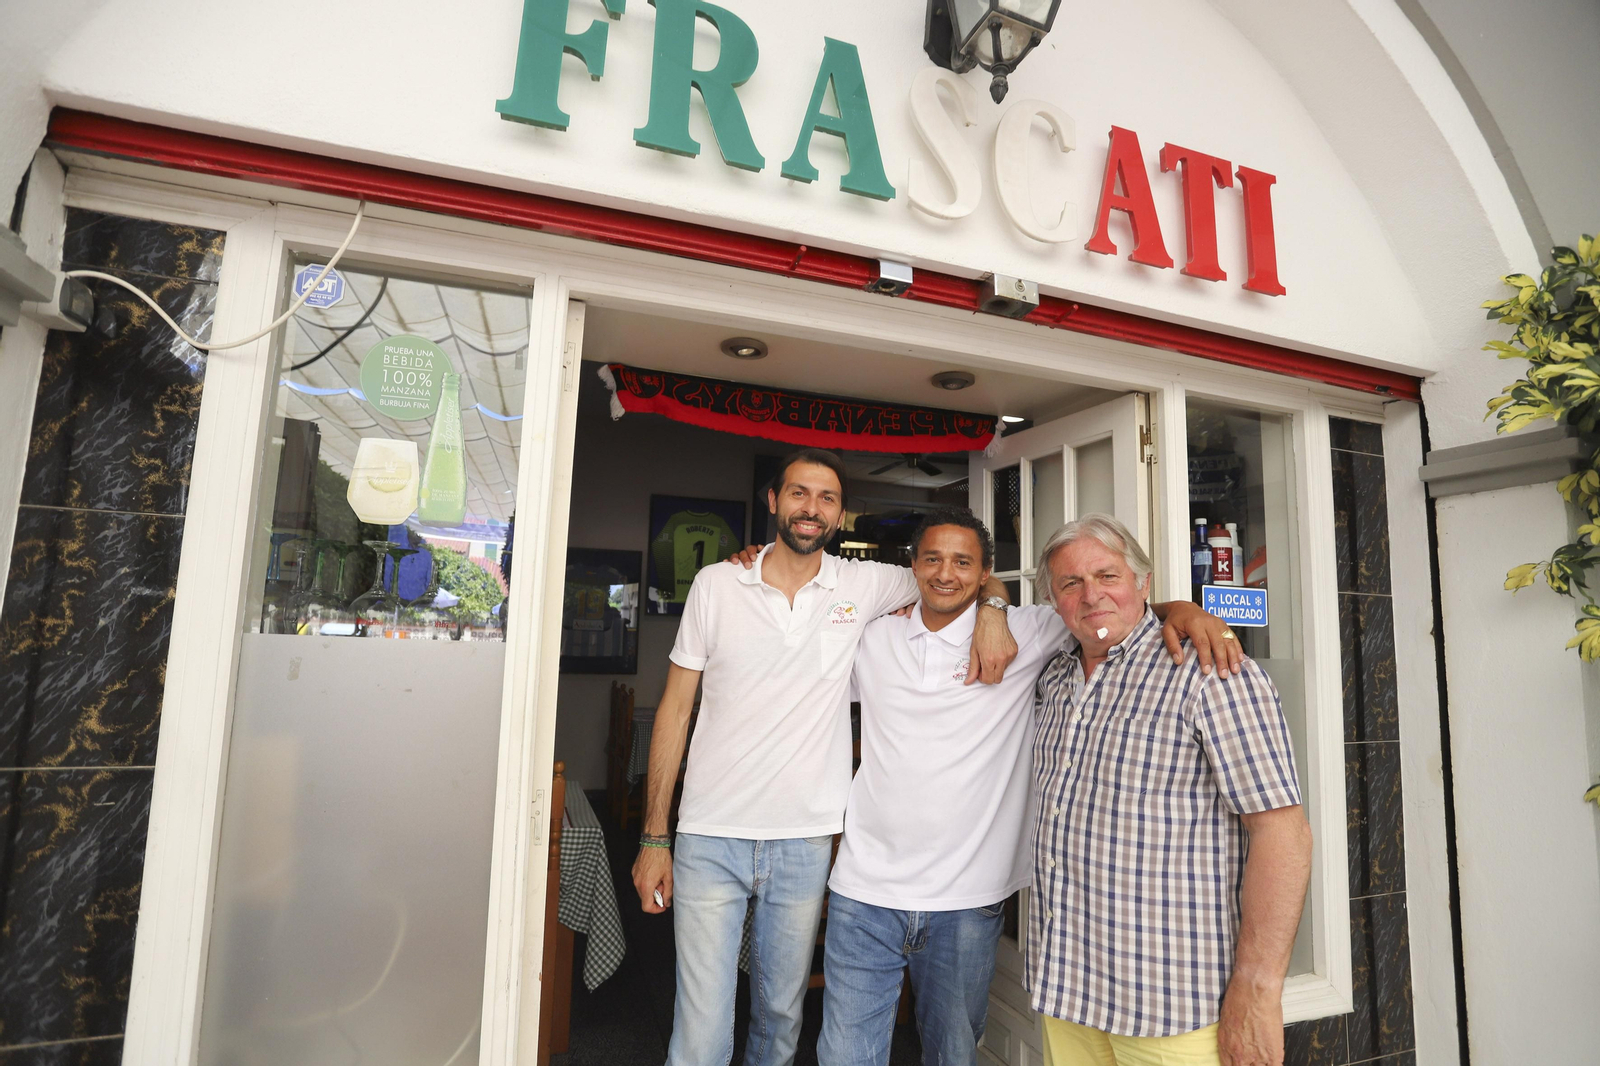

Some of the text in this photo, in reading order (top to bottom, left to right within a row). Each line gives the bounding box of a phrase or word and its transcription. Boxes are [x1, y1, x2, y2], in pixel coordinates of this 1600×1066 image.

[495, 0, 1288, 298] FRASCATI
[302, 277, 337, 293] ADT
[384, 345, 435, 358] PRUEBA UNA
[383, 354, 433, 369] BEBIDA
[382, 368, 433, 388] 100%
[380, 385, 431, 397] MANZANA
[379, 398, 430, 410] BURBUJA FINA
[441, 396, 456, 454] Appletiser
[686, 525, 715, 537] ROBERTO
[692, 540, 705, 570] 1
[1218, 560, 1230, 573] K
[575, 588, 605, 619] 19
[1220, 593, 1252, 606] LOCAL
